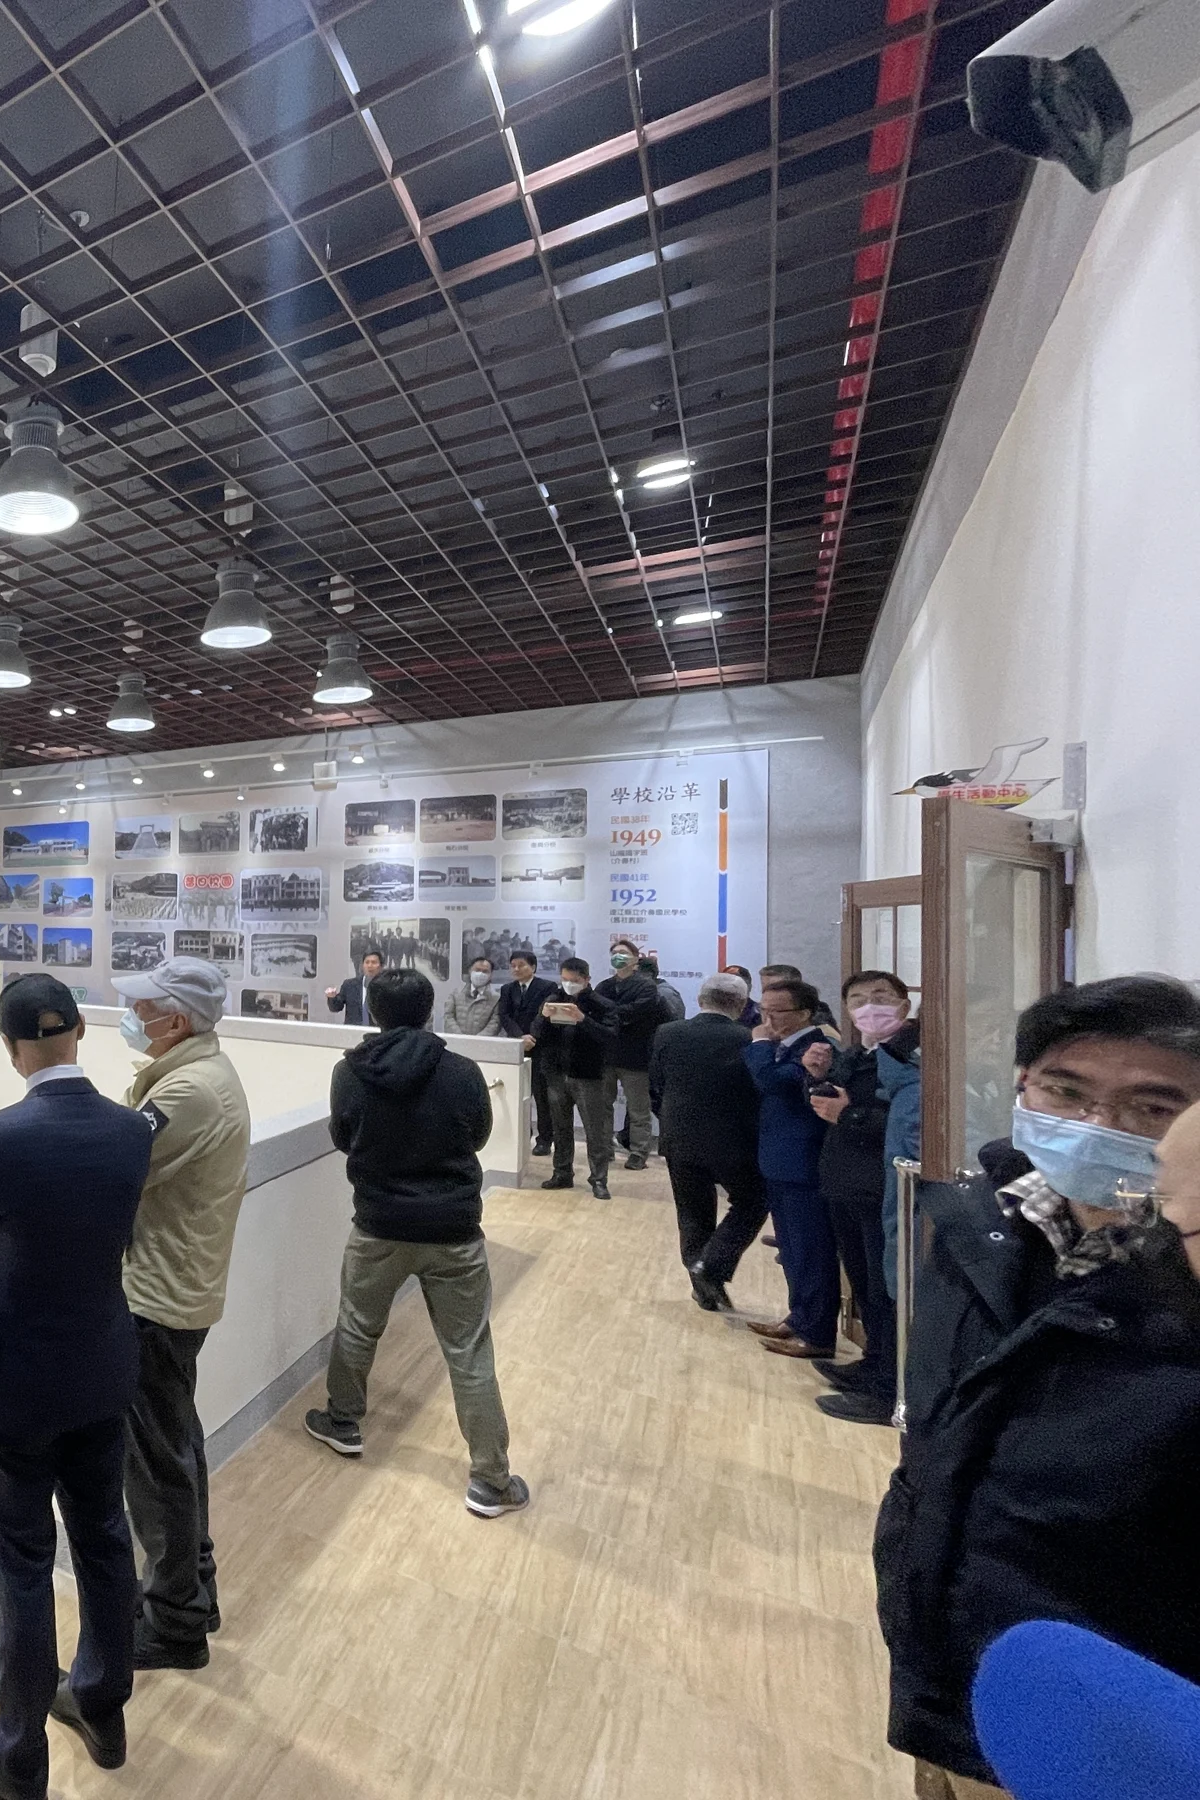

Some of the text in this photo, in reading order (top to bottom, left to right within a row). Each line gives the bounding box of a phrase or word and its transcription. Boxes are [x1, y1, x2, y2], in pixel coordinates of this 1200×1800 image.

[610, 782, 701, 805] 學校沿革
[610, 828, 662, 847] 1949
[610, 873, 649, 882] 民國41年
[610, 888, 657, 906] 1952
